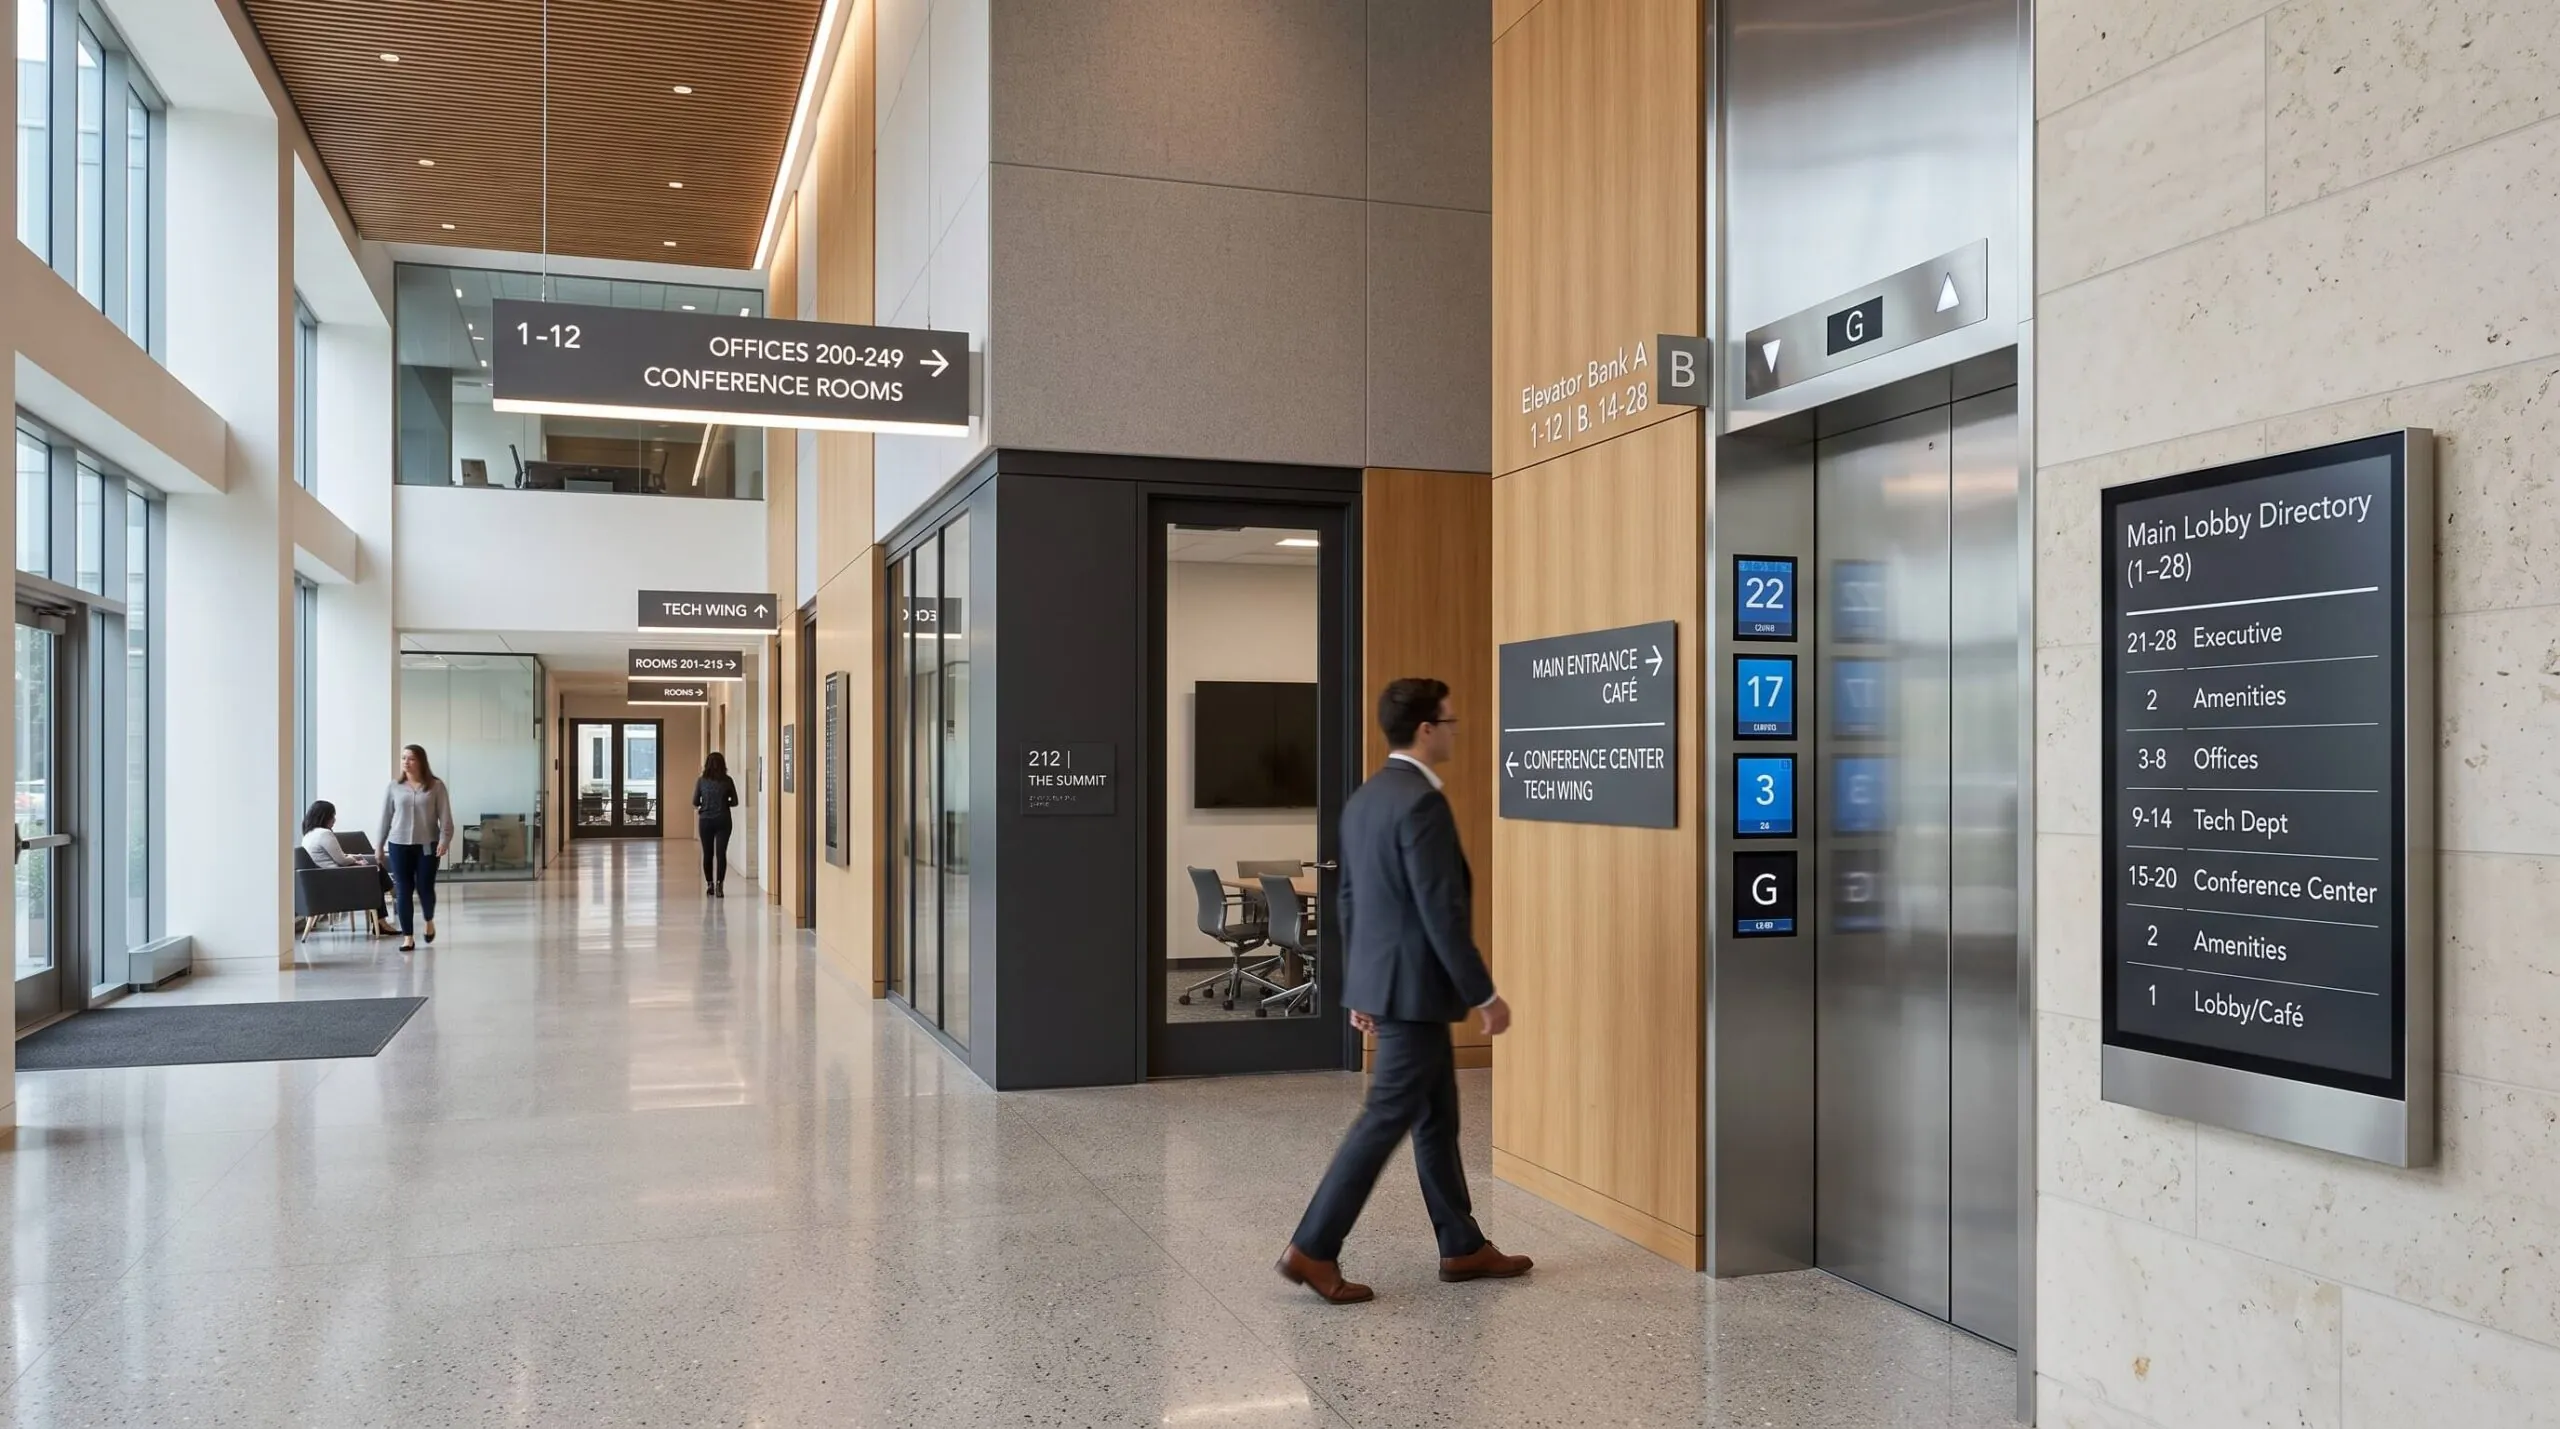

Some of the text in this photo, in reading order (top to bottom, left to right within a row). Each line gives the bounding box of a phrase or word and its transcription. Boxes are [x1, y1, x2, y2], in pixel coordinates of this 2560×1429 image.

[516, 322, 581, 350] 1-12
[1846, 311, 1864, 342] G
[709, 336, 904, 369] OFFICES 200-249
[643, 366, 904, 402] CONFERENCE ROOMS
[1522, 341, 1649, 415] Elevator Bank A
[1671, 350, 1696, 388] B
[1530, 412, 1563, 449] 1-12
[1577, 404, 1593, 432] B.
[1598, 381, 1649, 425] 14-28
[2127, 494, 2373, 548] Main Lobby Directory
[1745, 577, 1784, 609] 22
[662, 602, 747, 618] TECH WING
[2127, 621, 2283, 654] 21-28 Executive
[635, 658, 678, 669] ROOMS
[1532, 647, 1638, 679] MAIN ENTRANCE
[1602, 676, 1638, 704] CAFÉ
[1747, 675, 1784, 707] 17
[2146, 684, 2287, 711] 2 Amenities
[1028, 750, 1061, 767] 212
[1523, 747, 1664, 770] CONFERENCE CENTER
[2138, 745, 2259, 770] 3-8 Offices
[1028, 774, 1107, 786] THE SUMMIT
[1523, 779, 1593, 801] TECH WING
[1755, 774, 1775, 806] 3
[2132, 806, 2289, 840] 9-14 Tech Dept
[1752, 873, 1778, 906] G
[2128, 865, 2378, 905] 15-20 Conference Center
[2147, 924, 2287, 962] 2 Amenities
[2148, 984, 2304, 1029] 1 Lobby/Café
